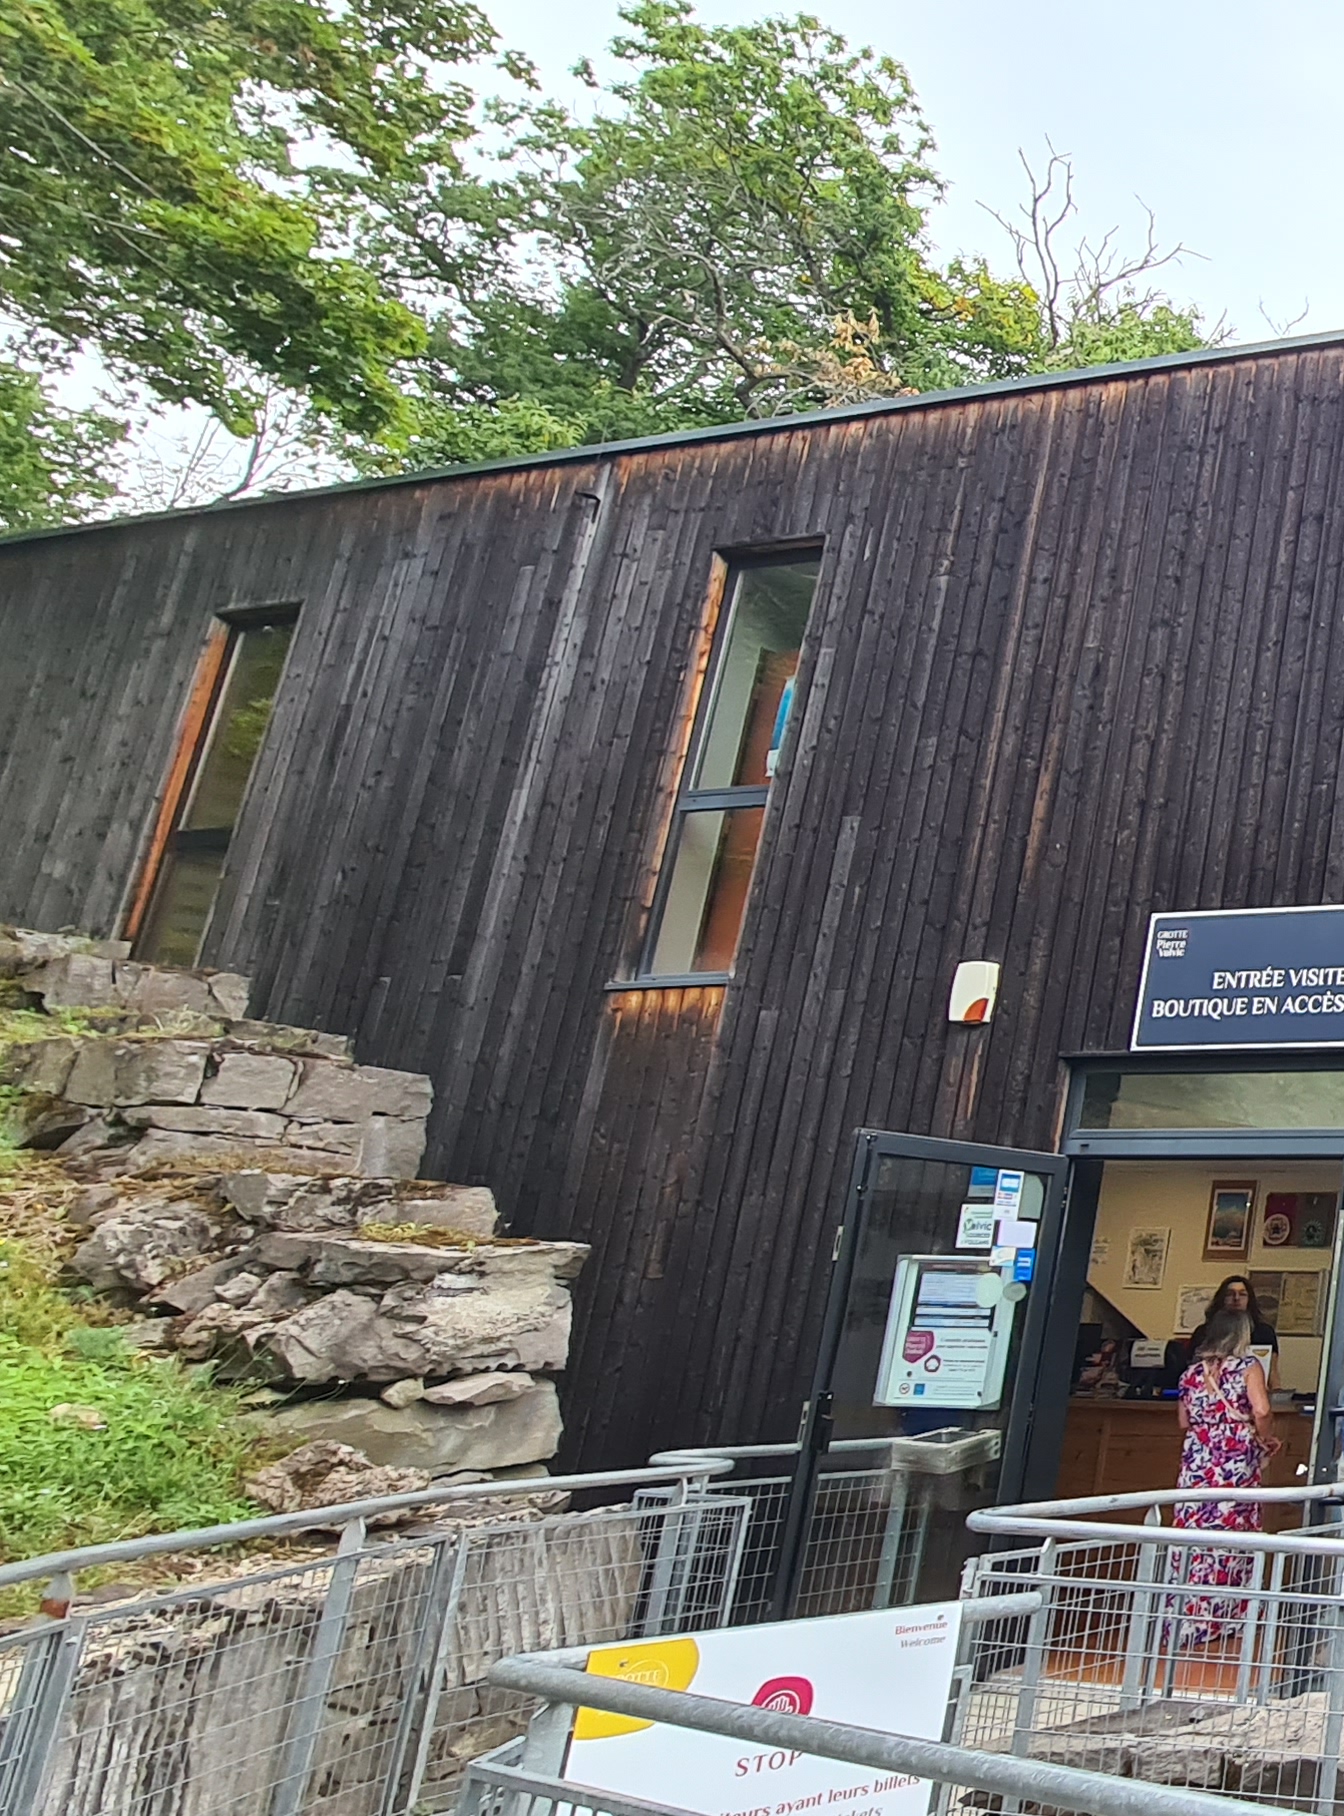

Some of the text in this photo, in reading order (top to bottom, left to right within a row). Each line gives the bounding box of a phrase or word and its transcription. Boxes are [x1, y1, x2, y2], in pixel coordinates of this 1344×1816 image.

[1156, 939, 1187, 950] Pierre
[1212, 966, 1285, 990] ENTRÉE
[1151, 996, 1249, 1020] BOUTIQUE
[1252, 996, 1278, 1016] EN
[895, 1621, 948, 1635] Bienvenue
[900, 1636, 946, 1649] Welcome
[734, 1750, 803, 1778] STOP
[775, 1792, 823, 1816] ayant
[827, 1783, 870, 1804] leurs
[873, 1775, 921, 1794] billets
